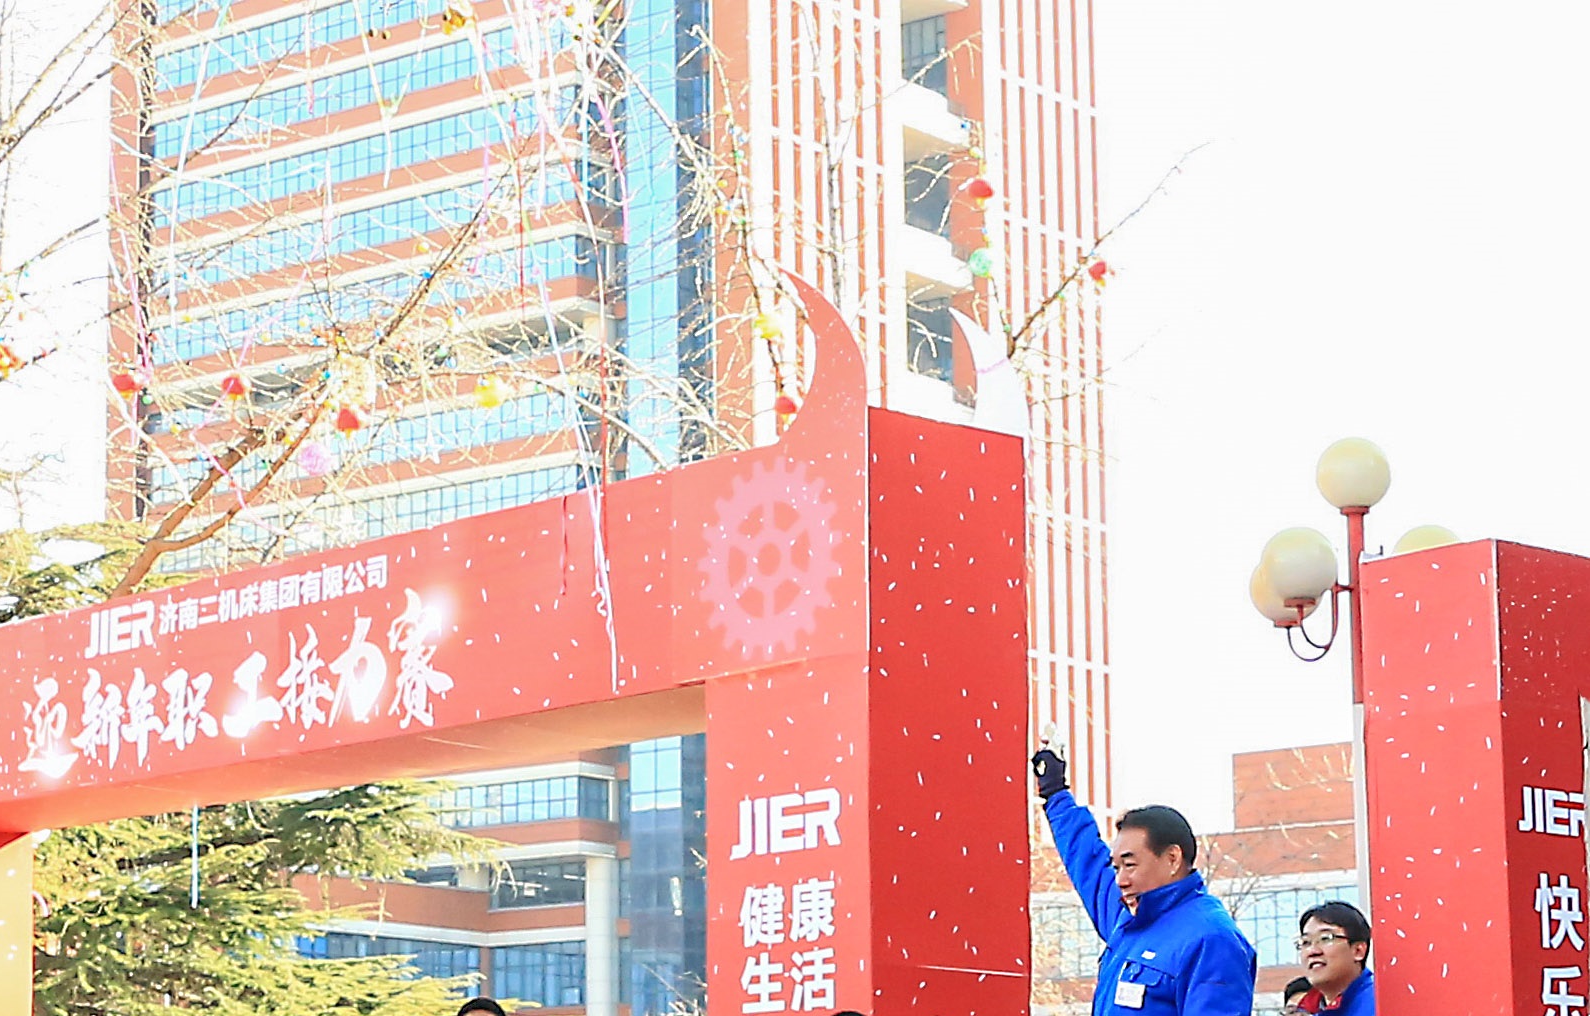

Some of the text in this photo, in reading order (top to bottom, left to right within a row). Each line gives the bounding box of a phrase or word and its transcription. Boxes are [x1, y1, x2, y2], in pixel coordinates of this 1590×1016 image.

[84, 600, 155, 658] JIER
[158, 555, 388, 635] 济南二机床集团有限公司
[18, 587, 454, 778] 迎新年职工接力赛
[729, 787, 841, 860] JIER
[1518, 786, 1586, 837] JIER
[738, 877, 836, 948] 健康
[740, 947, 836, 1014] 生活
